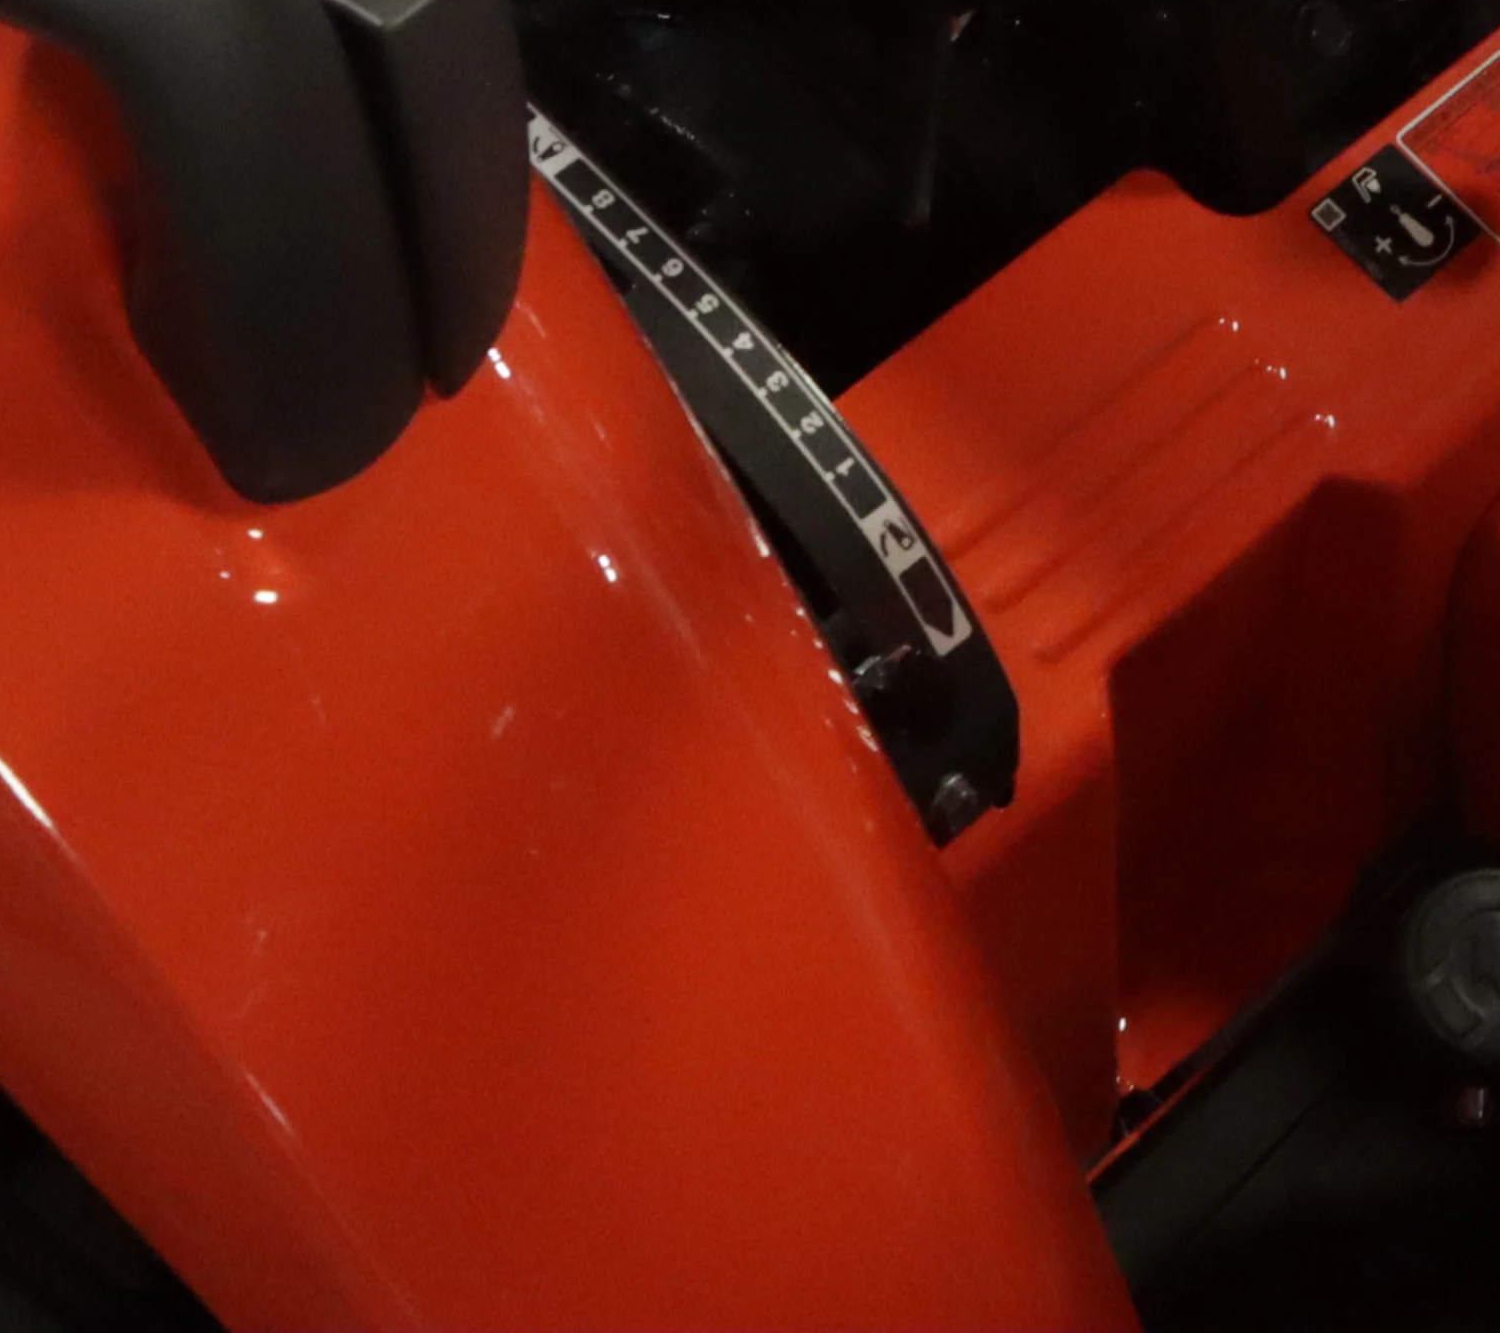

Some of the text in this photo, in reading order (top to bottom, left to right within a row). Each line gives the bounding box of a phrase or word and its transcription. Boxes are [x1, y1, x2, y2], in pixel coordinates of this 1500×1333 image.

[591, 190, 855, 476] 1 2 3 4 5 6 7 8
